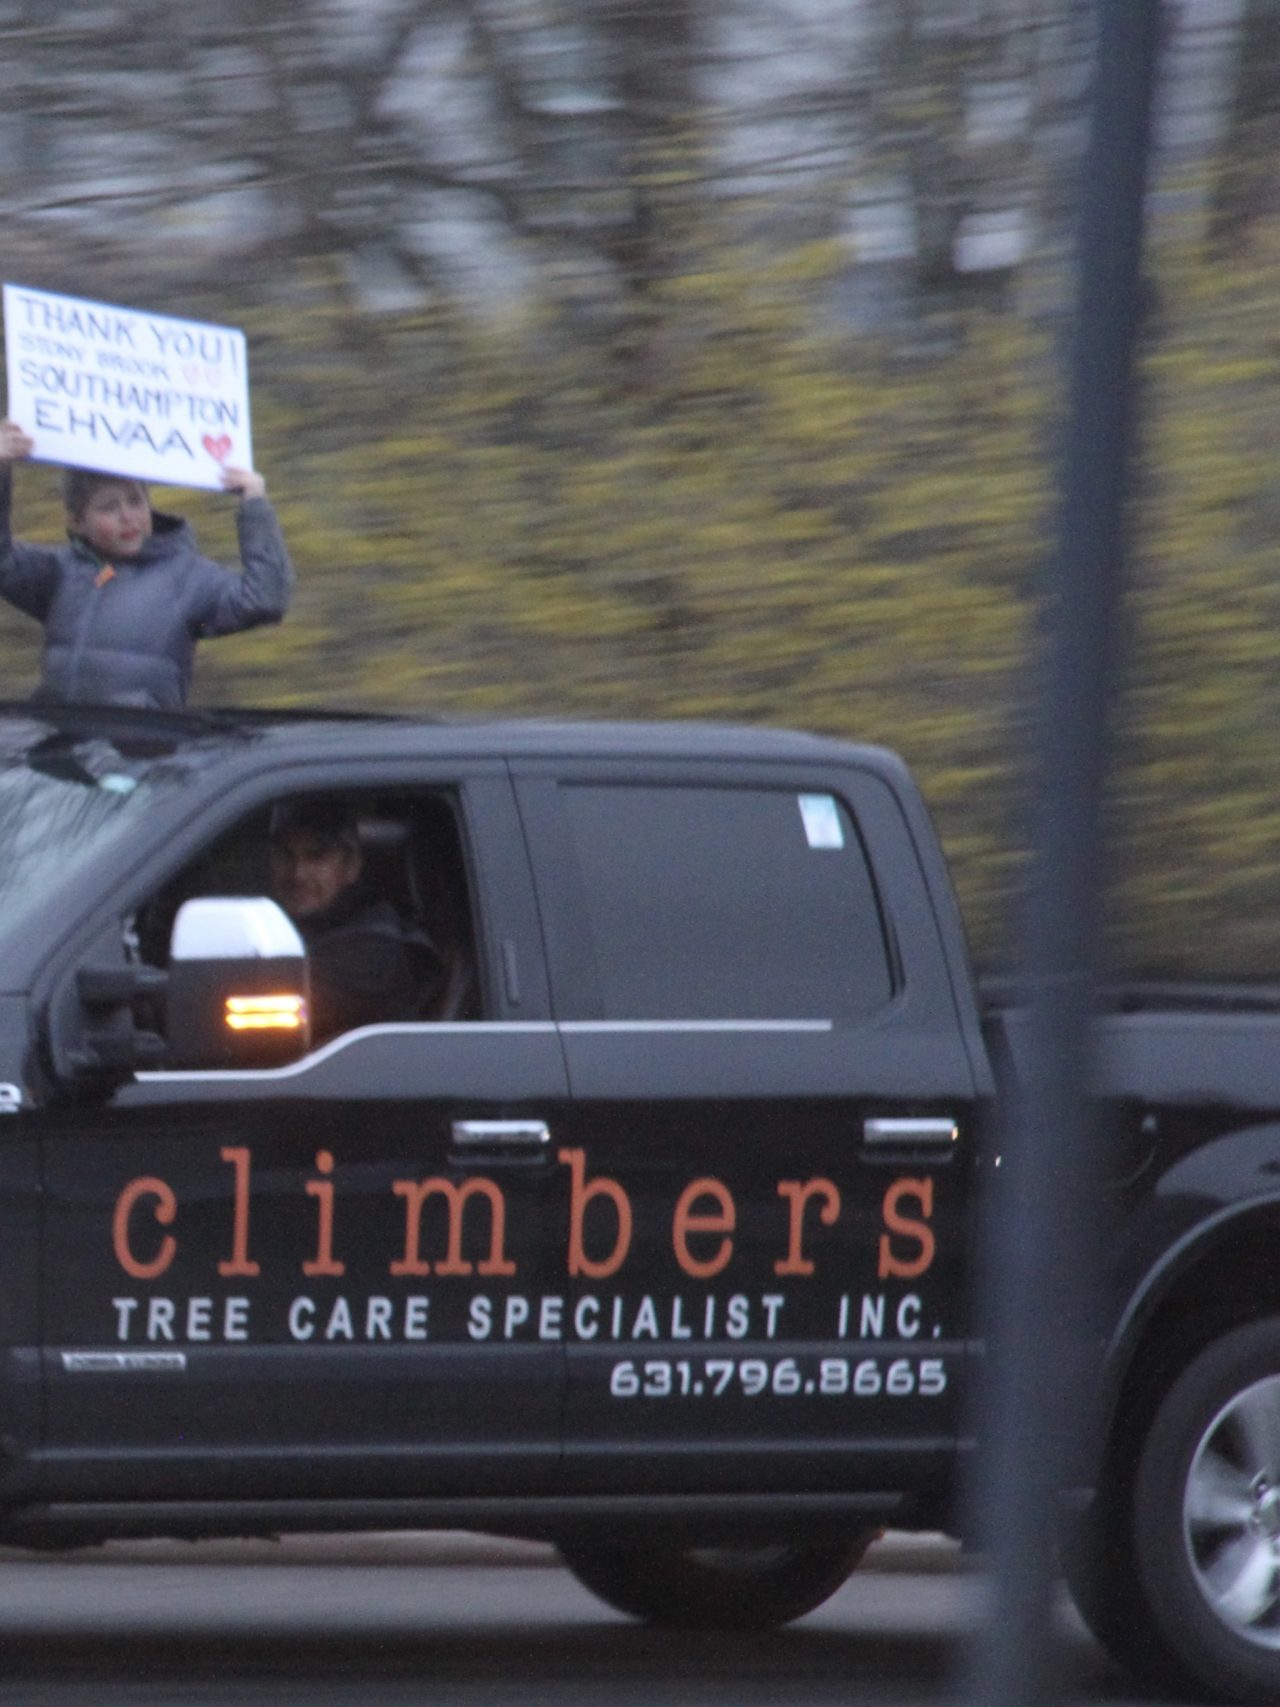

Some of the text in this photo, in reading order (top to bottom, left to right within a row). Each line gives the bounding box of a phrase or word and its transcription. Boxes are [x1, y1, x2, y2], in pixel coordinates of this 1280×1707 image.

[17, 297, 240, 377] THANK YOU!
[19, 359, 239, 428] SOUTHAMPTON
[34, 397, 195, 459] EHVAA
[113, 1146, 936, 1279] climbers
[112, 1294, 943, 1341] TREE CARE SPECIALIST INC.
[609, 1358, 948, 1397] 631.796.8665
